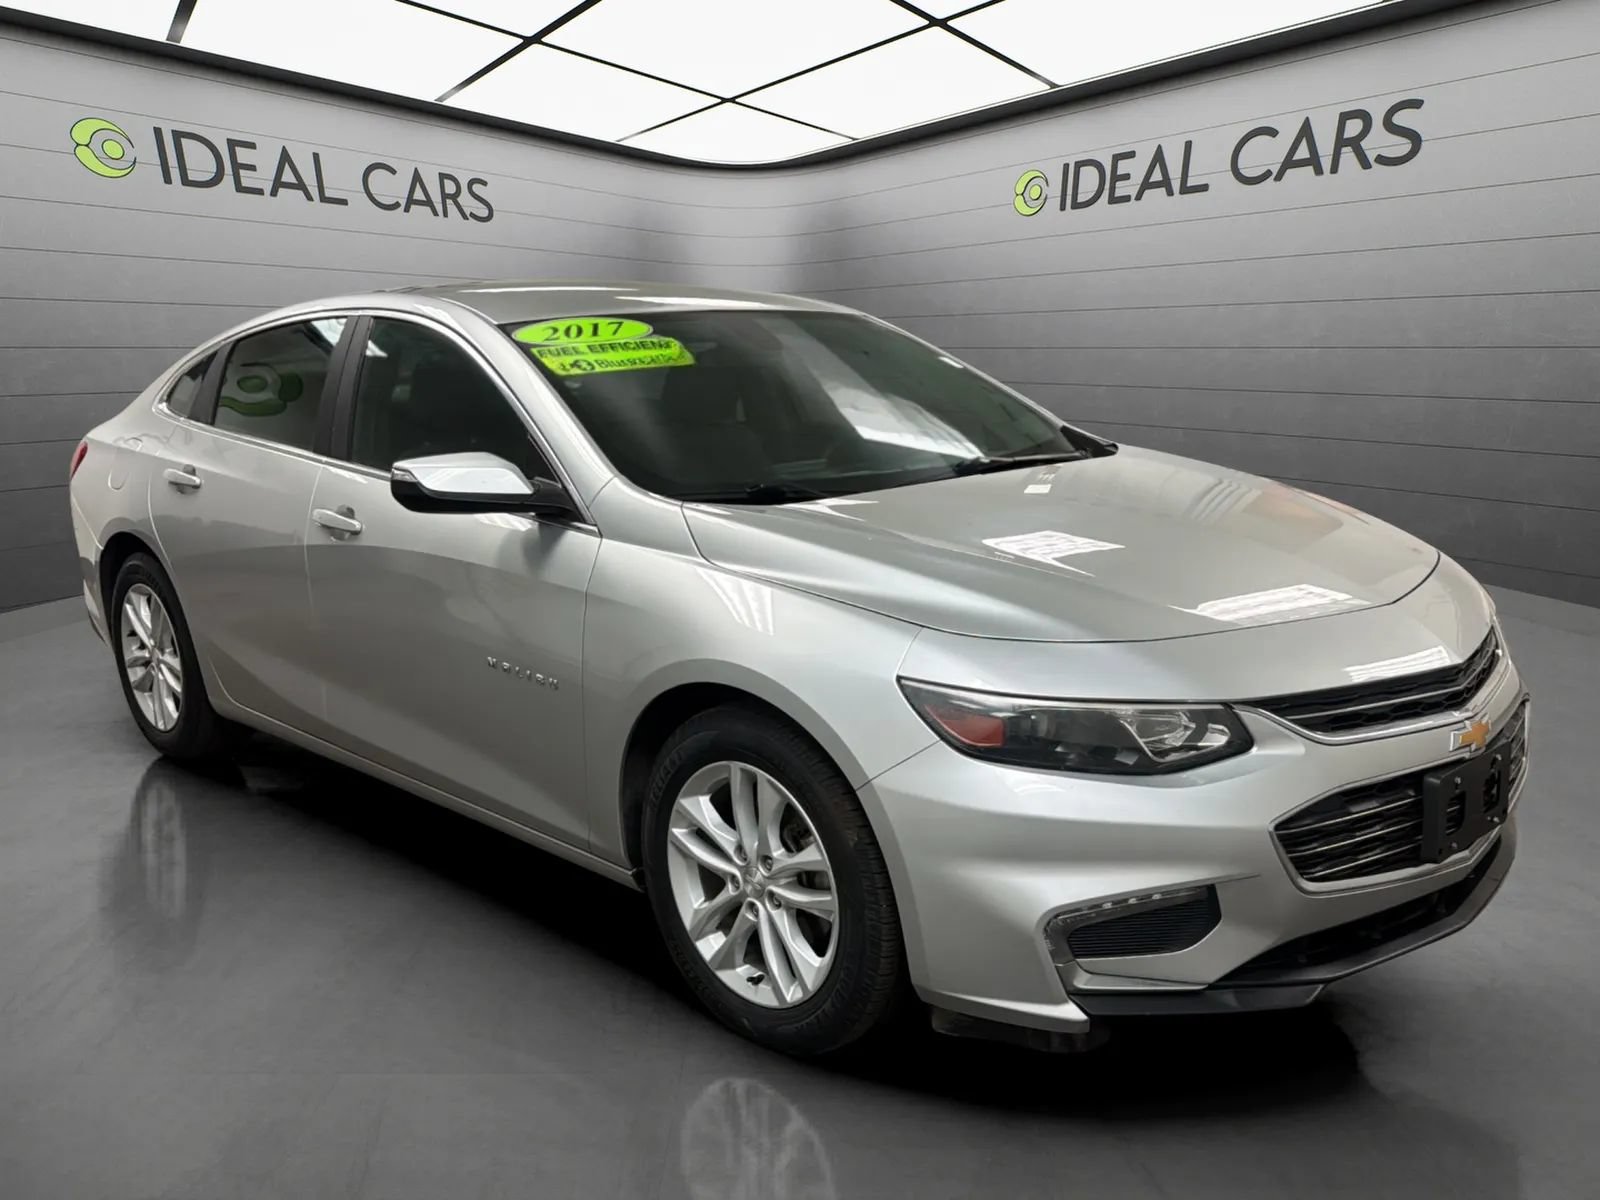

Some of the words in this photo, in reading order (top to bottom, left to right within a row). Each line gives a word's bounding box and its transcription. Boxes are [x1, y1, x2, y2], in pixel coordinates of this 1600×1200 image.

[152, 126, 349, 206] IDEAL
[362, 162, 494, 223] CARS
[1060, 140, 1210, 212] IDEAL
[1230, 98, 1425, 186] CARS
[537, 346, 588, 359] FUEL
[543, 321, 625, 342] 2017
